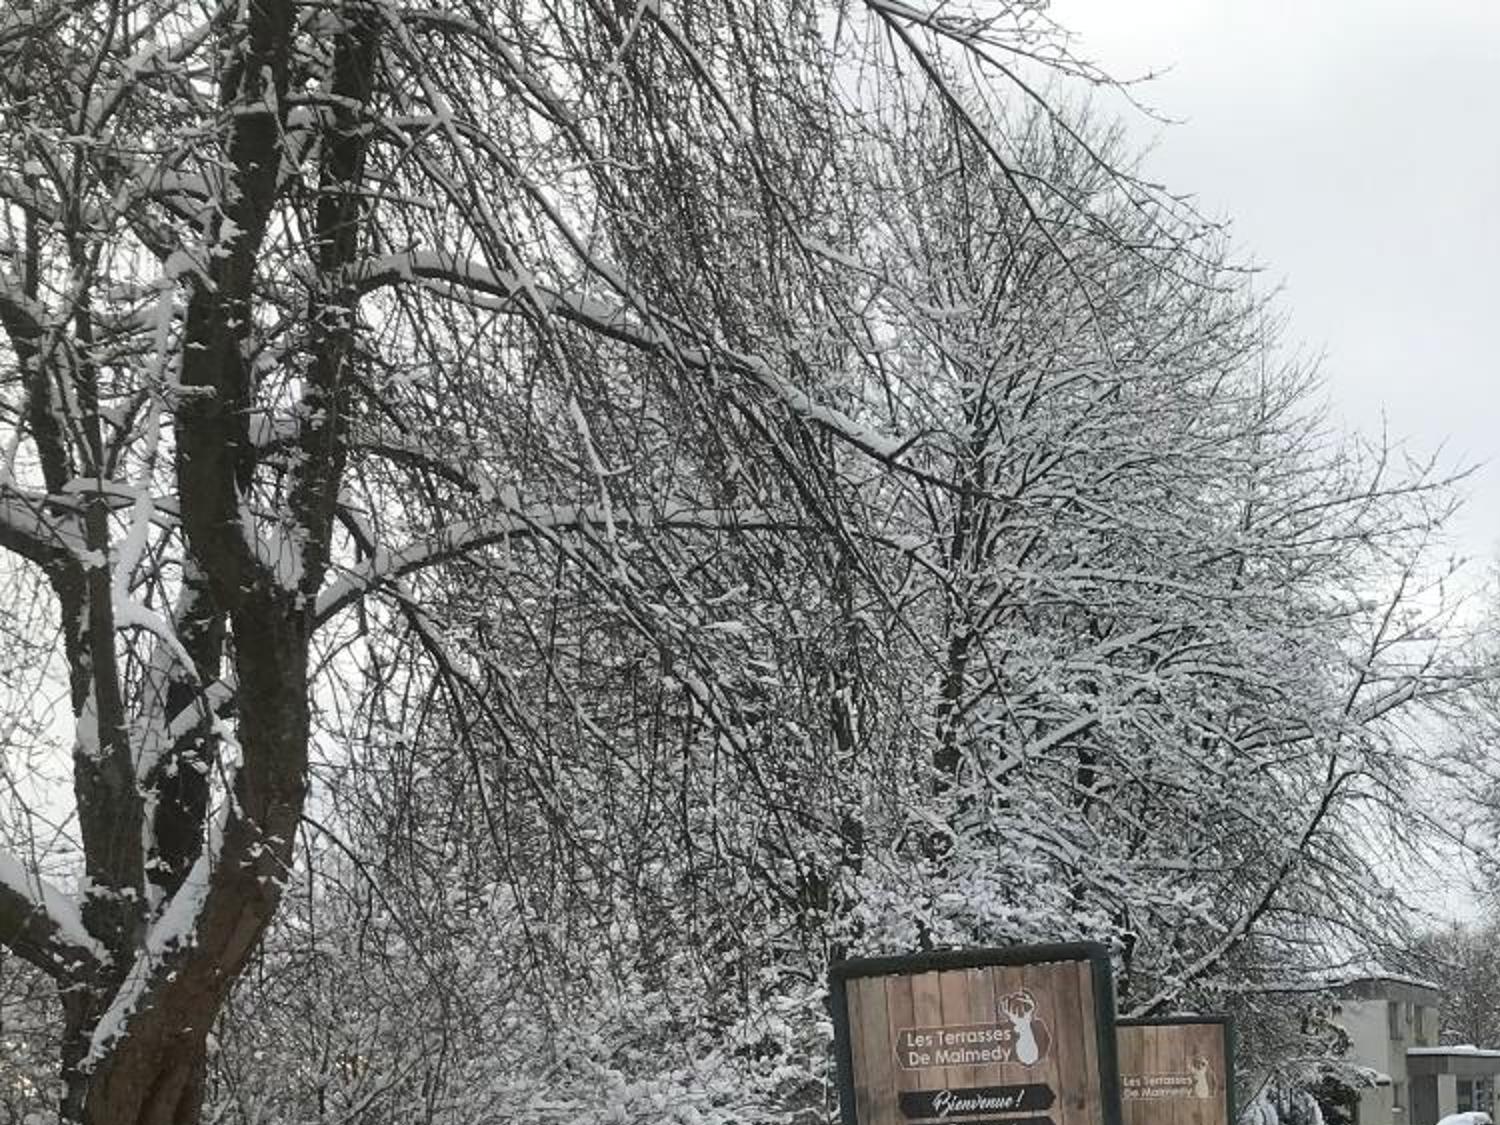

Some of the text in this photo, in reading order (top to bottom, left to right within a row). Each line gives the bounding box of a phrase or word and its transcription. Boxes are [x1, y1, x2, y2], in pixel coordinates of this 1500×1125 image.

[907, 1028, 1011, 1047] Les Terrasses
[909, 1046, 1011, 1066] De Malmedy
